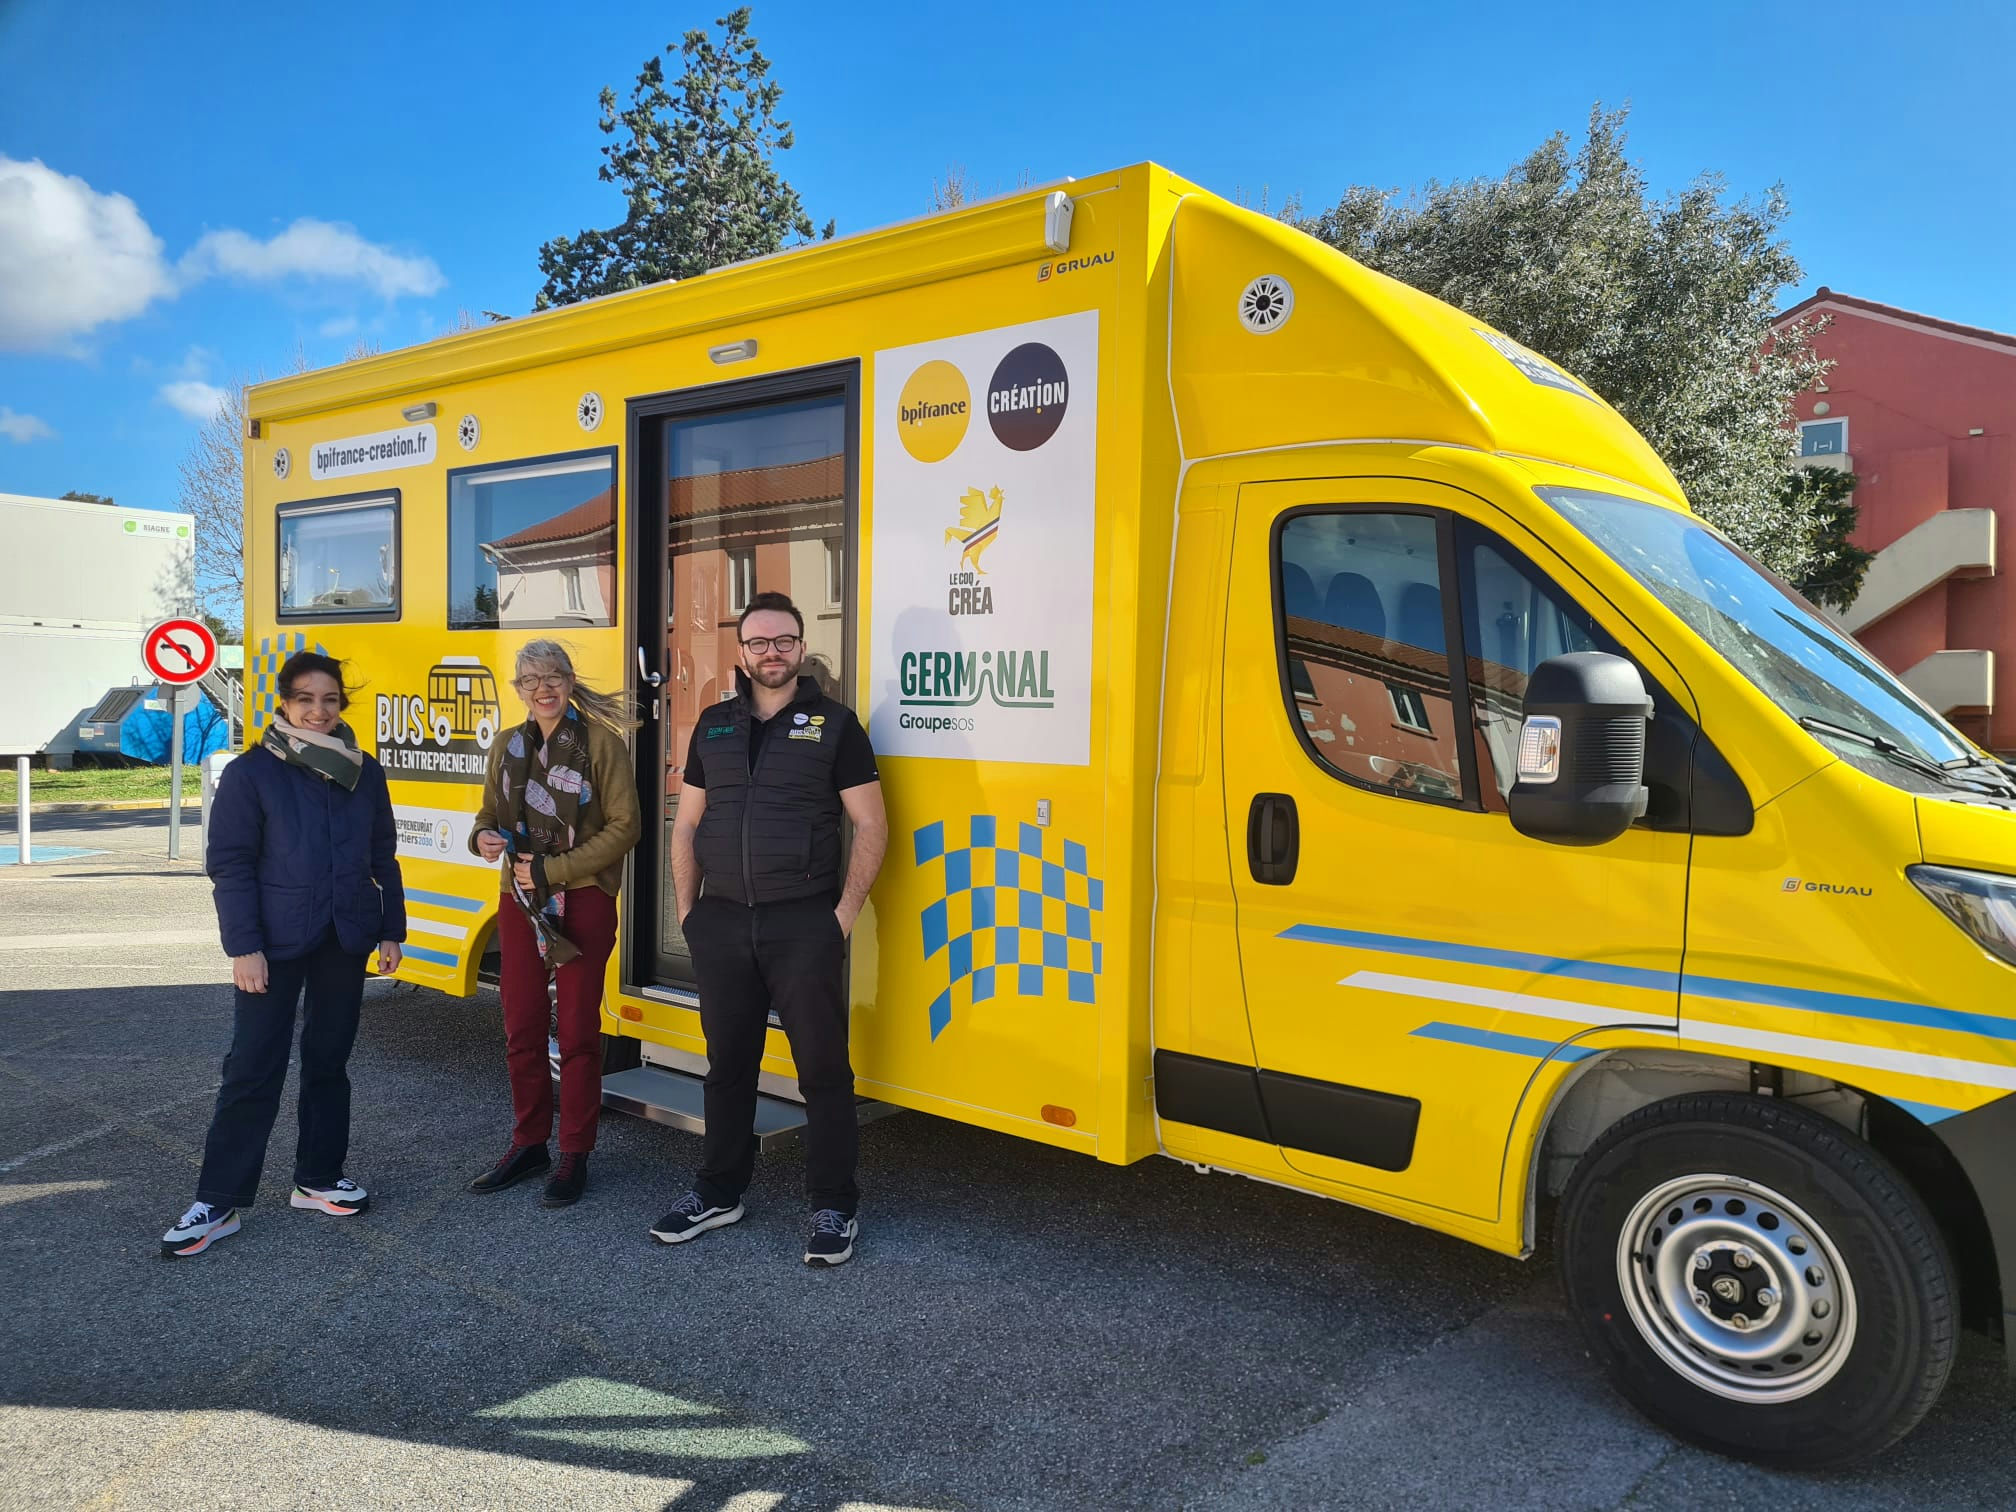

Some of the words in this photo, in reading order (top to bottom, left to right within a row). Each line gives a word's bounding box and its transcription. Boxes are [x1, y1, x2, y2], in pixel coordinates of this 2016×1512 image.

[1056, 251, 1115, 274] GRUAU
[901, 400, 966, 425] bpifrance
[317, 431, 427, 474] bpifrance-creation.fr
[949, 573, 958, 586] LE
[959, 571, 974, 587] COQ
[948, 580, 994, 616] CRÉA
[376, 692, 425, 746] BUS
[379, 747, 393, 768] DE
[393, 749, 490, 775] L'ENTREPRENEURIA
[1804, 882, 1873, 897] GRUAU
